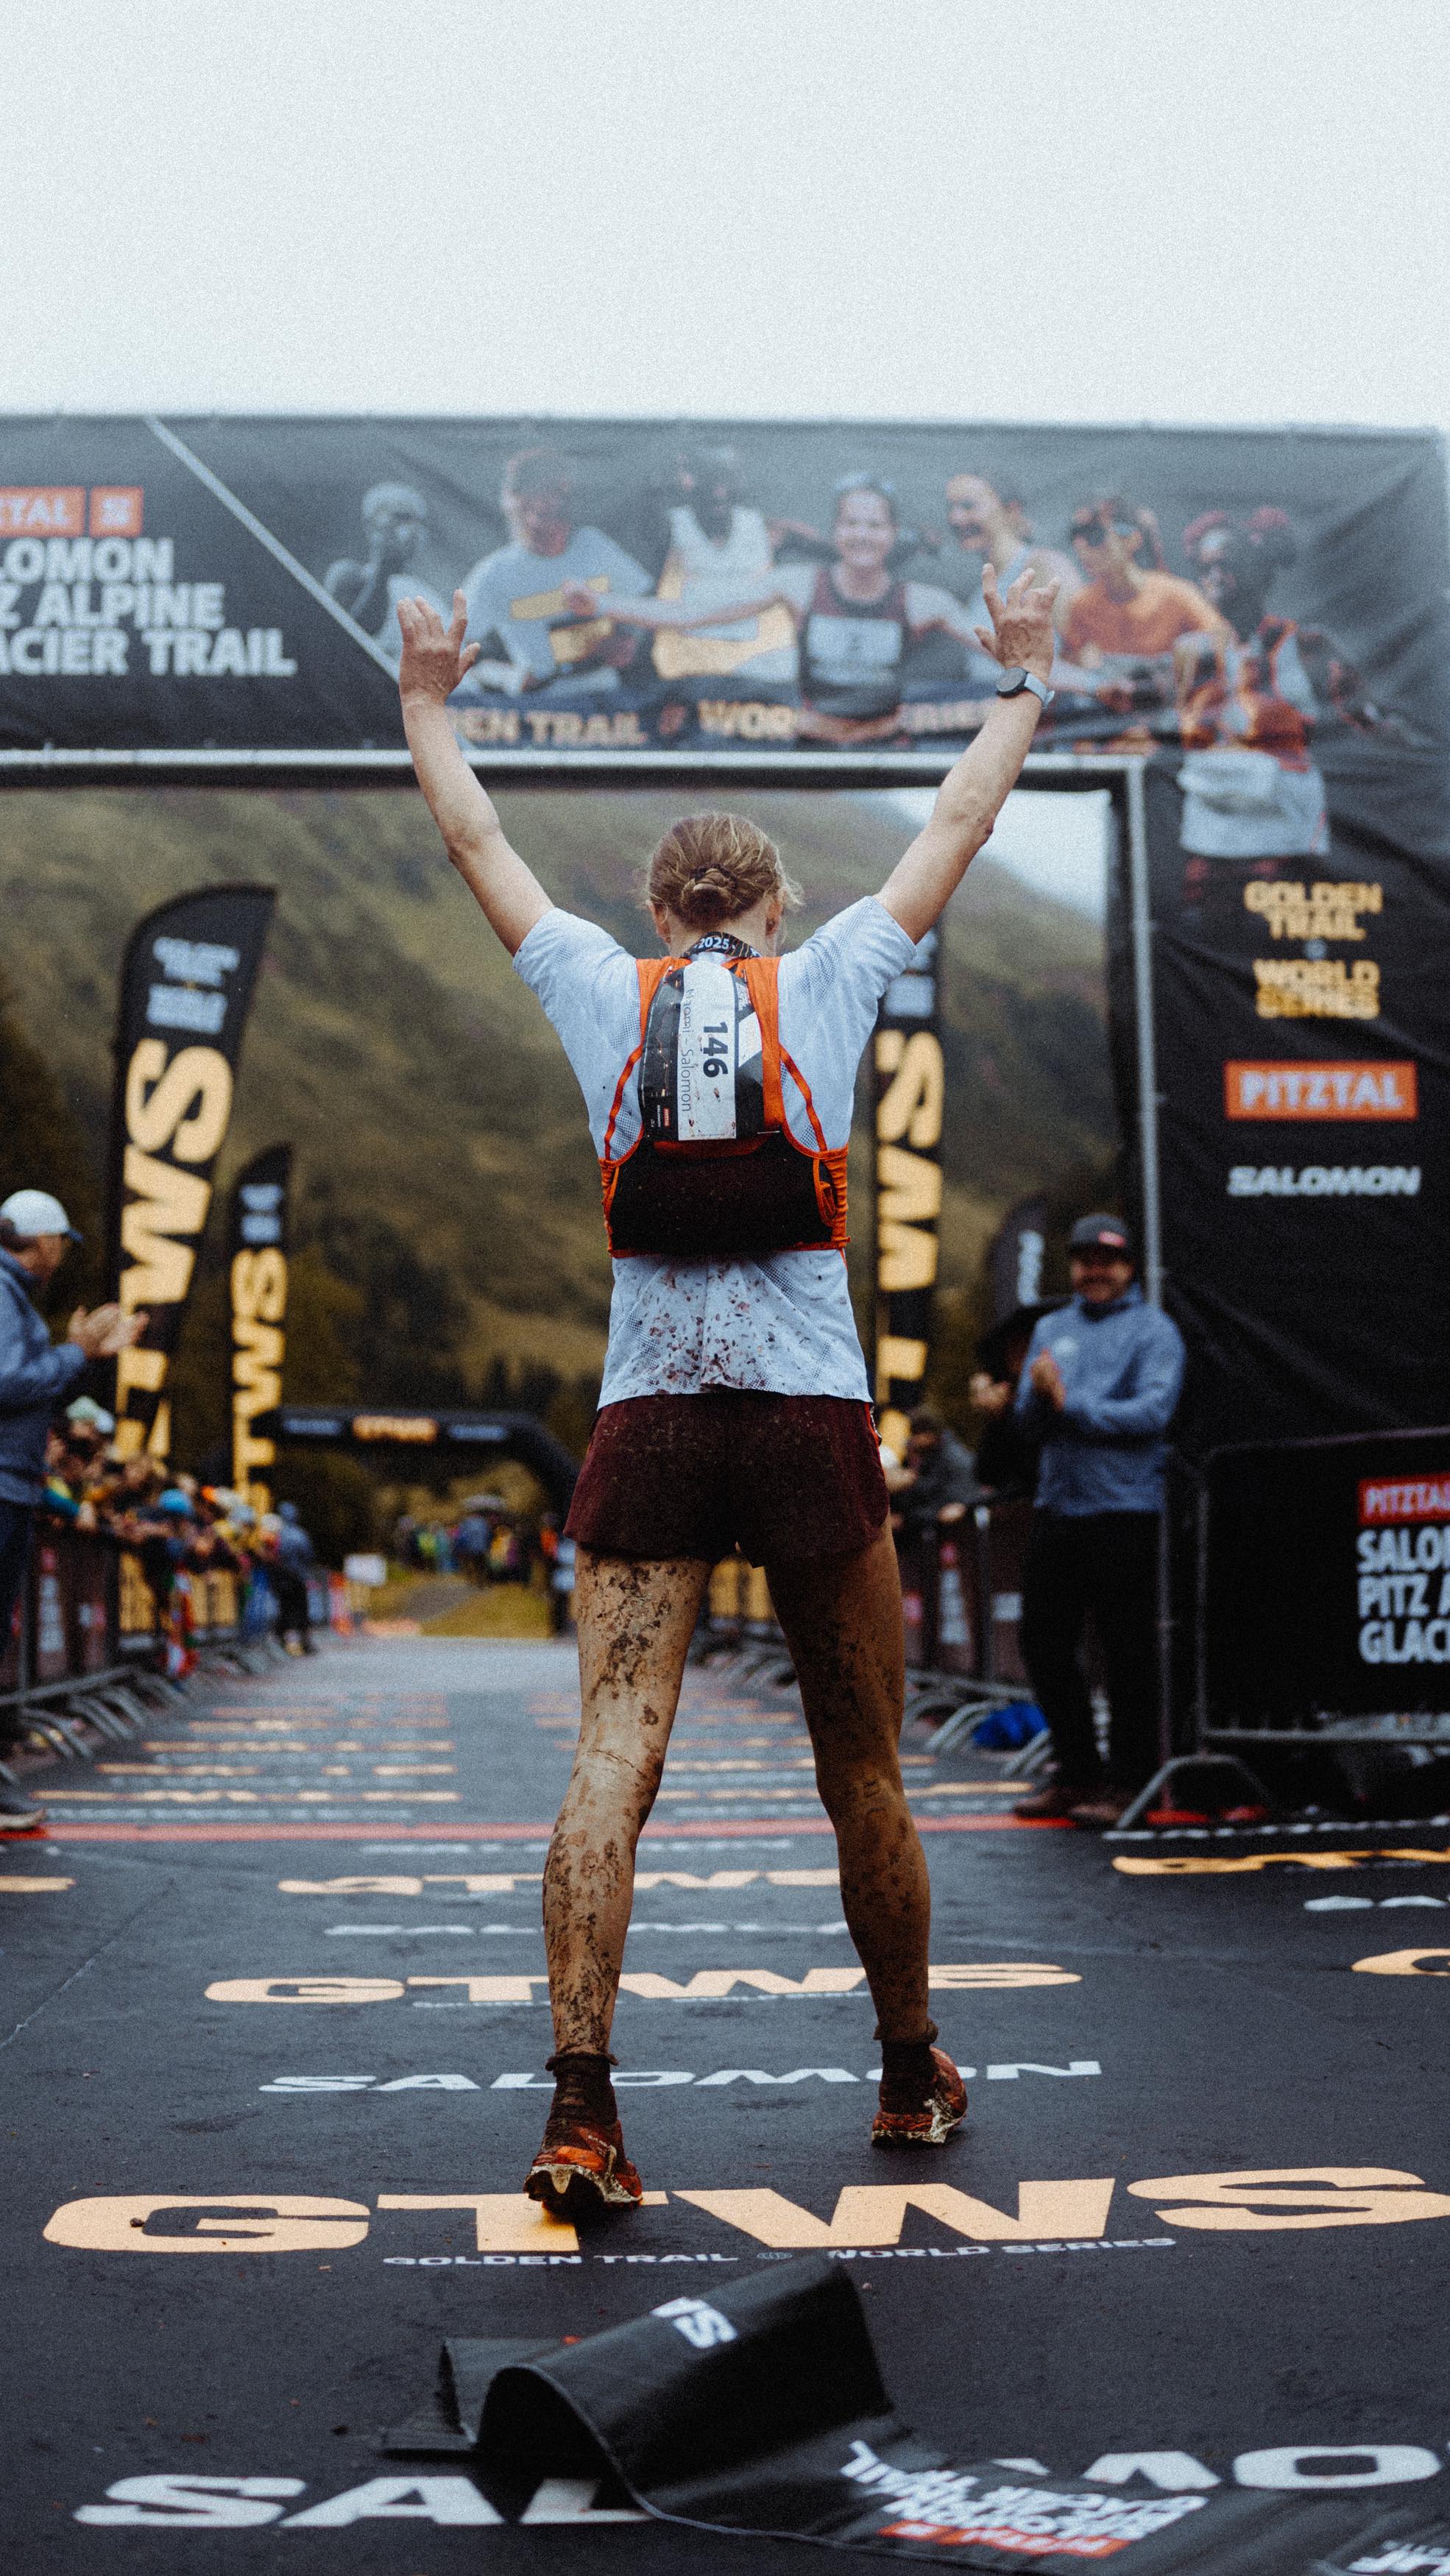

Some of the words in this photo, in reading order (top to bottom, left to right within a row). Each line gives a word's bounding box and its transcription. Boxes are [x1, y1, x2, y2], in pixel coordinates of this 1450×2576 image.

[0, 537, 174, 584] OMON
[32, 582, 225, 630] ALPINE
[141, 627, 297, 677] TRAIL
[1244, 882, 1384, 914] GOLDEN
[698, 935, 730, 951] 2025
[1264, 910, 1367, 941] TRAIL
[1252, 959, 1381, 988] WORLD
[682, 988, 695, 1033] Naomi
[1256, 986, 1381, 1019] SERIES
[703, 1022, 729, 1078] 146
[681, 1048, 694, 1112] Salomon
[1239, 1072, 1405, 1110] PITZTAL
[1227, 1166, 1421, 1196] SALOMON
[1358, 1574, 1430, 1618] PITZ
[43, 2166, 1450, 2253] GTWS
[383, 2254, 582, 2266] GOLDEN
[593, 2252, 739, 2265] TRAIL
[1001, 2237, 1176, 2254] SERIES
